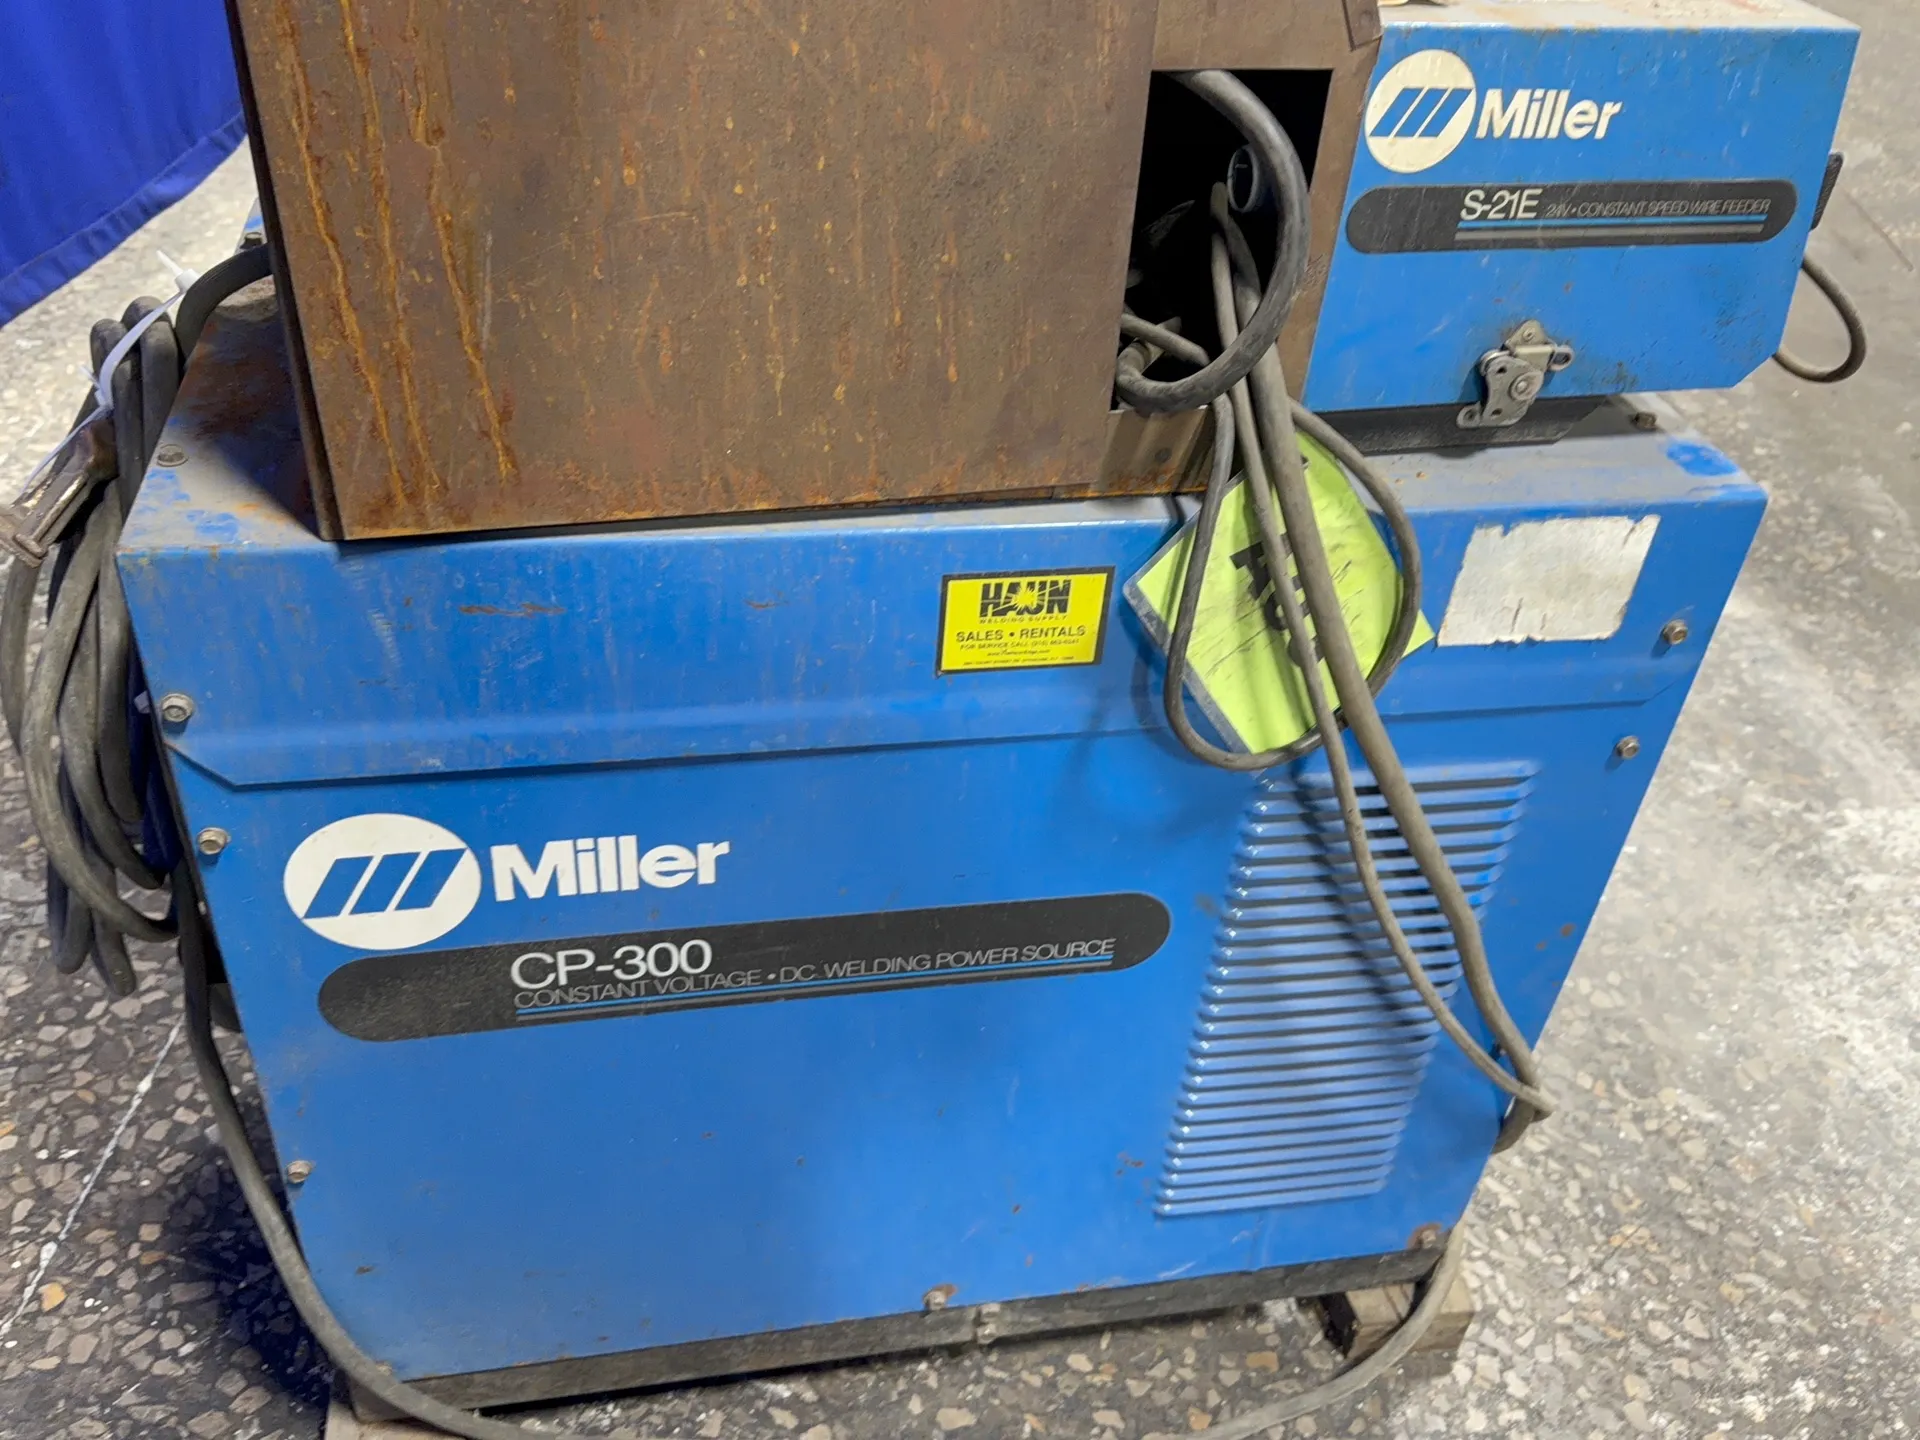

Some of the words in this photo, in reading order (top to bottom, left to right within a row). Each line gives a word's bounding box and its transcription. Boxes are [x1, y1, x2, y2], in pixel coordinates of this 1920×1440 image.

[1474, 88, 1623, 140] Miller
[1460, 188, 1542, 220] S-21E
[1576, 201, 1646, 217] CONSTANT
[1648, 200, 1690, 215] SPEED
[1690, 200, 1722, 214] WIRE
[1722, 199, 1771, 213] FEEDER
[955, 629, 1004, 643] SALES
[1019, 625, 1086, 639] RENTALS
[490, 834, 730, 902] Miller
[509, 939, 713, 990] CP-300
[513, 980, 651, 1009] CONSTANT
[653, 969, 763, 996] VOLTAGE
[779, 966, 816, 984] DC
[822, 953, 932, 980] WELDING
[934, 946, 1018, 970] POWER
[1020, 938, 1117, 960] SOURCE
